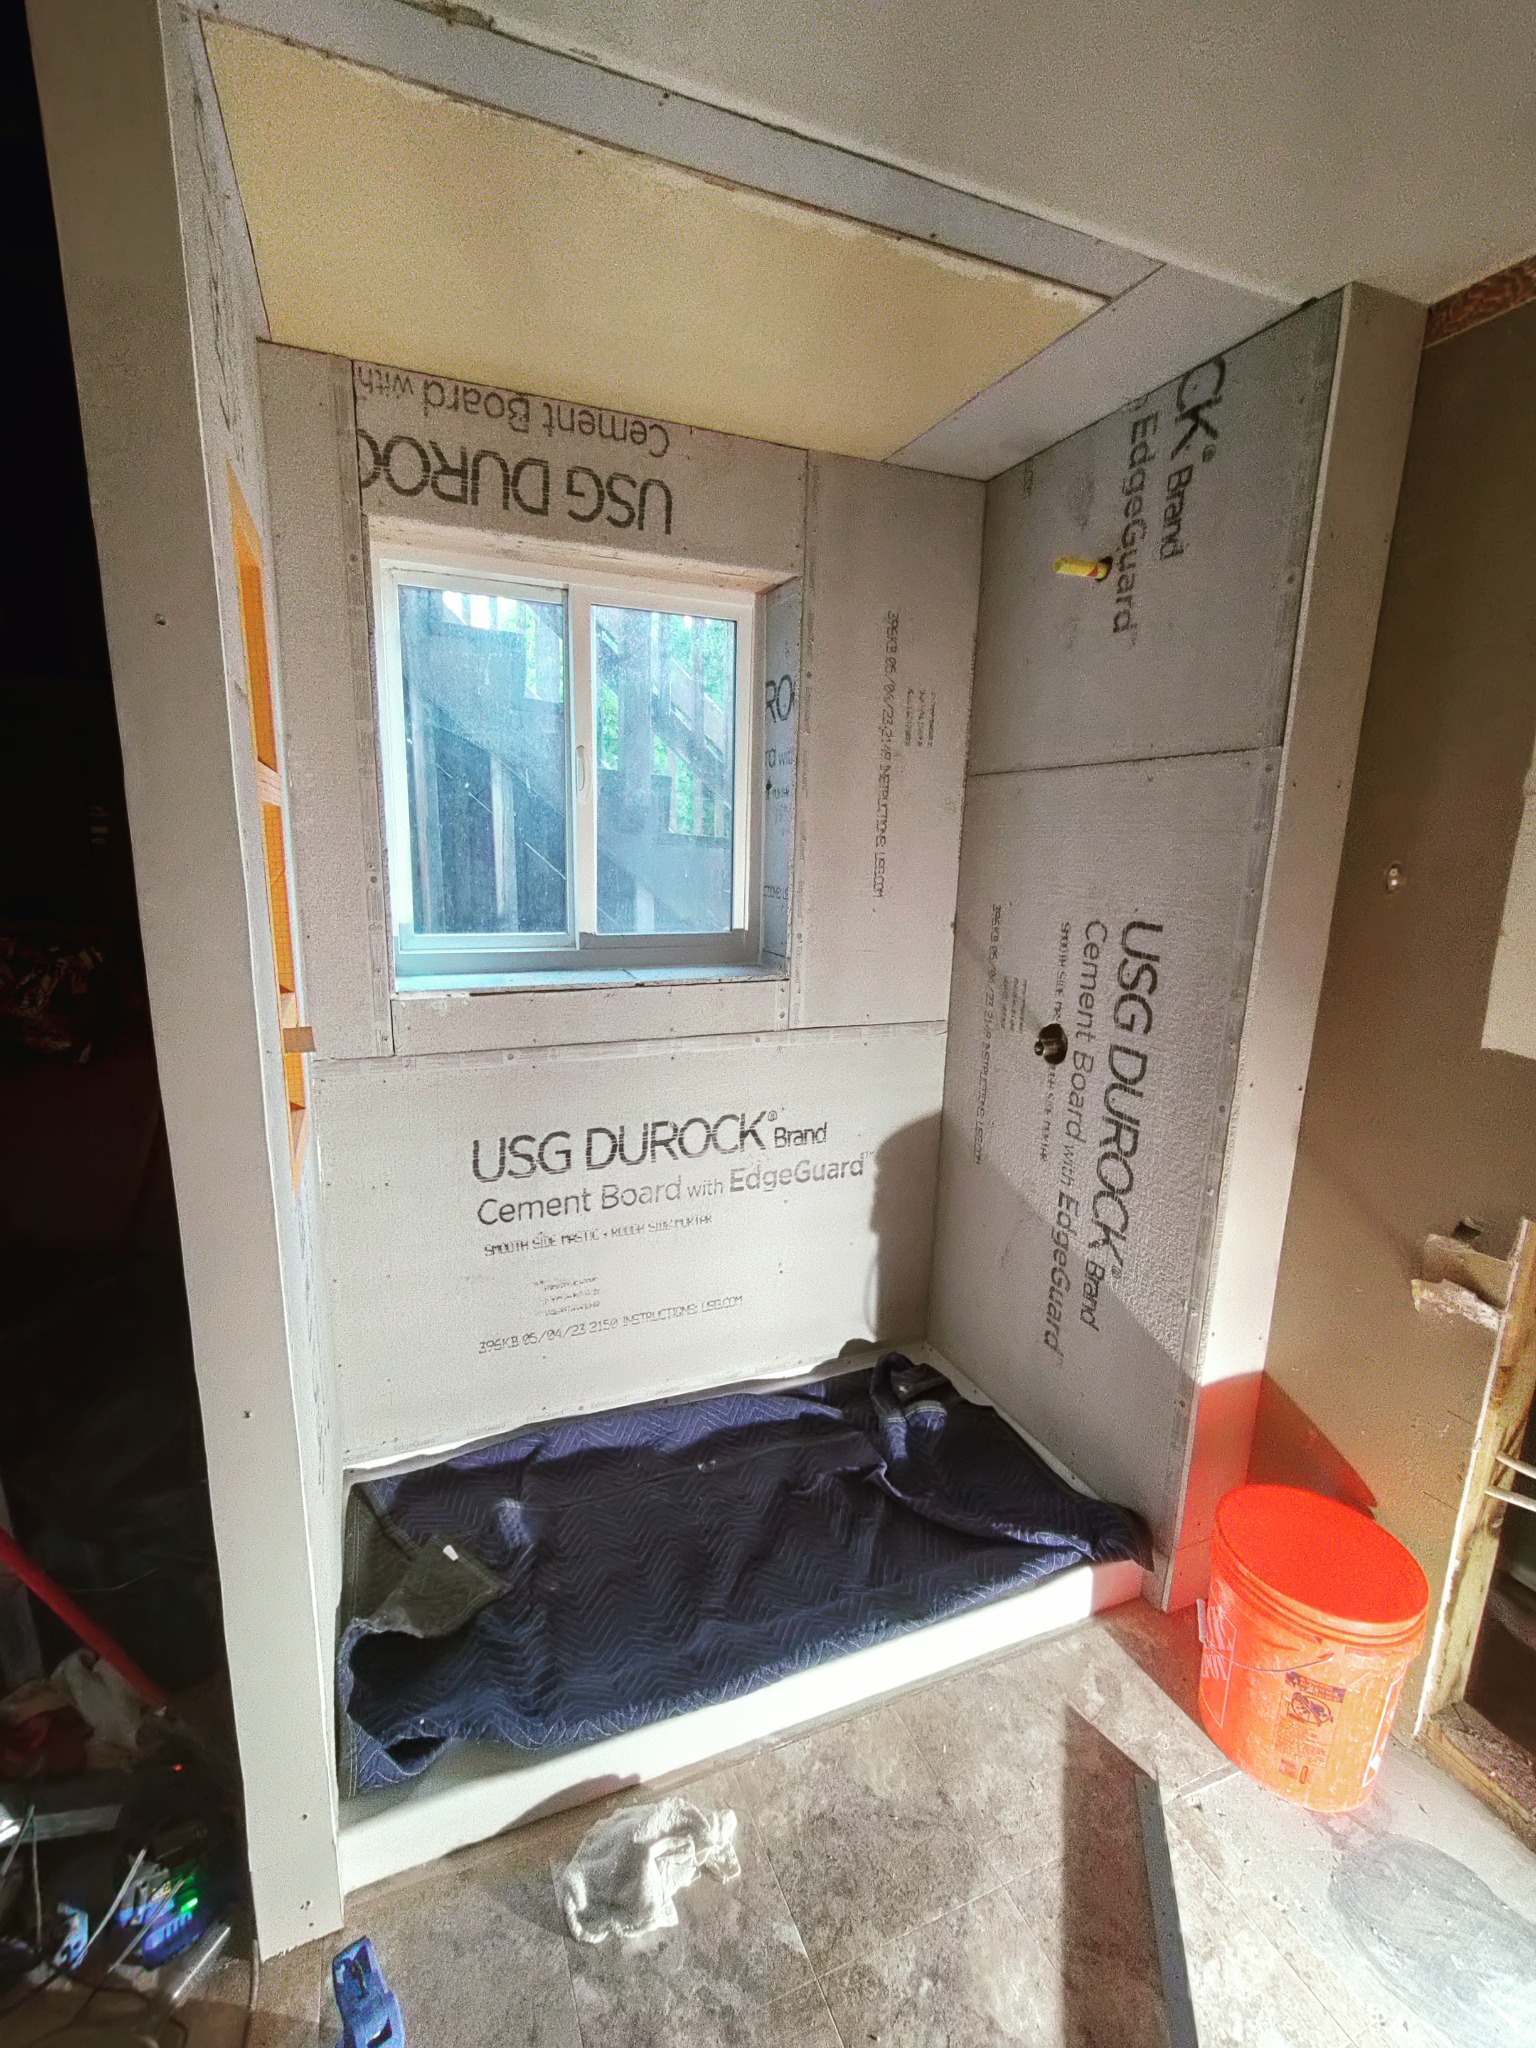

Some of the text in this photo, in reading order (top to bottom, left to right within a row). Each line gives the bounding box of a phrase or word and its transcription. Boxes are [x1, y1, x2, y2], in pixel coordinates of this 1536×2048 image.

[360, 365, 669, 457] Cement Board with
[359, 428, 672, 534] USG DUROC
[1113, 411, 1159, 634] EdgeGuard
[1159, 464, 1194, 561] Brand
[1078, 920, 1108, 1041] Cement
[1113, 920, 1163, 1036] USG
[1066, 1054, 1095, 1144] Board
[471, 1130, 572, 1184] USG
[773, 1121, 828, 1149] Brand
[1058, 1142, 1077, 1187] with
[477, 1189, 592, 1227] Cement
[601, 1175, 682, 1210] Board
[686, 1178, 724, 1200] with
[484, 1241, 529, 1257] SMOOTH
[1080, 1260, 1105, 1332] Brand
